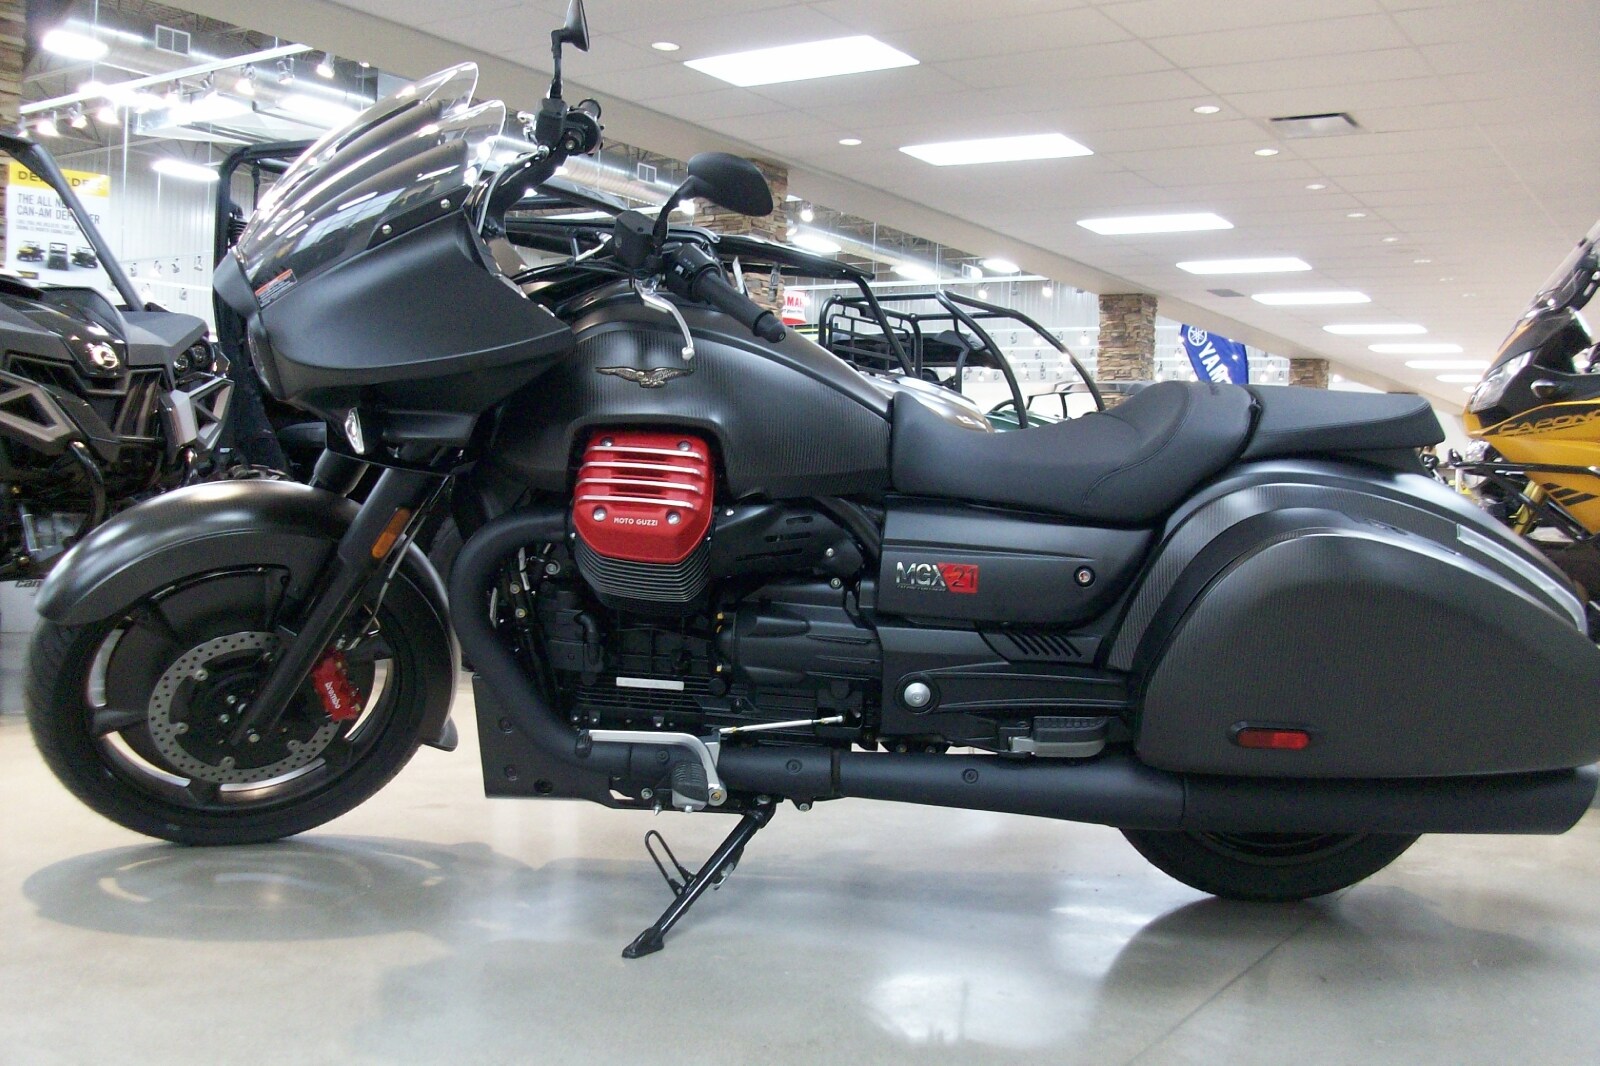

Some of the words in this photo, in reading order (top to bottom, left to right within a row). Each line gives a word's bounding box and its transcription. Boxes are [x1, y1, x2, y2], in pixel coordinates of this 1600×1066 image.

[17, 193, 34, 205] THE
[37, 196, 52, 207] ALL
[16, 205, 52, 218] CAN-AM
[613, 516, 635, 525] MOTO
[635, 518, 659, 527] GUZZI
[324, 681, 341, 709] brembo
